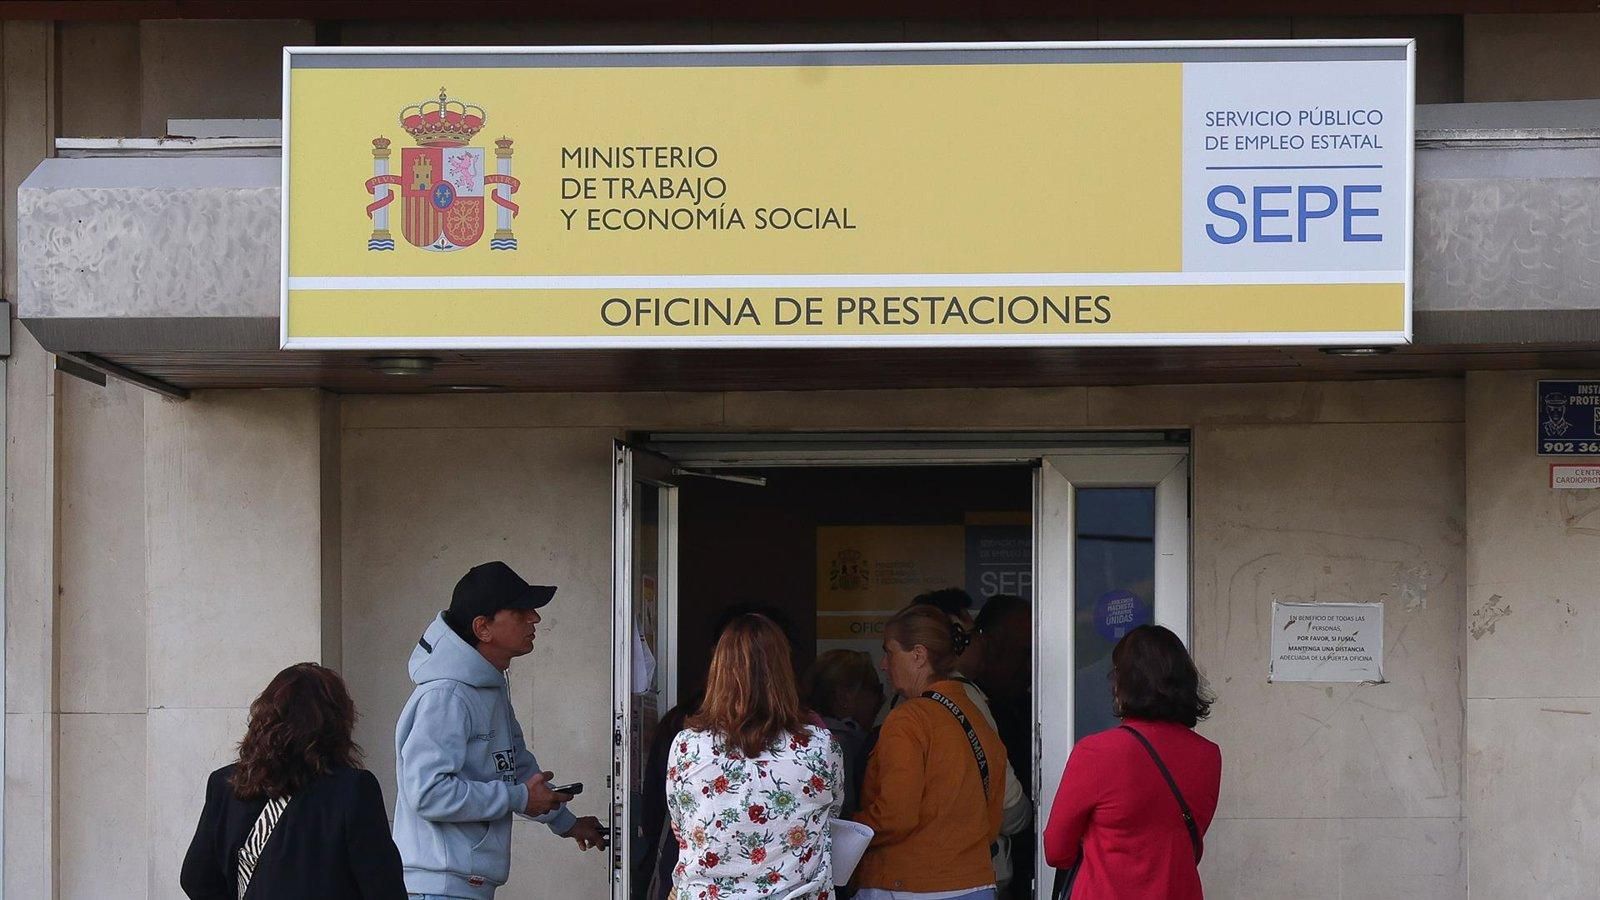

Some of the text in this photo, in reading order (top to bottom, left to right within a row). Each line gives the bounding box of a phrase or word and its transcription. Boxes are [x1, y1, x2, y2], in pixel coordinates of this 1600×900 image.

[1205, 105, 1383, 127] SERVICIO PÚBLICO
[1205, 134, 1383, 151] DE EMPLEO ESTATAL
[561, 146, 718, 169] MINISTERIO
[562, 177, 727, 206] DE TRABAJO
[561, 200, 857, 231] Y ECONOMÍA SOCIAL
[1204, 184, 1383, 245] SEPE
[600, 295, 1111, 327] OFICINA DE PRESTACIONES
[1543, 442, 1600, 453] 902 36
[931, 692, 987, 769] BIMBA BIMBA
